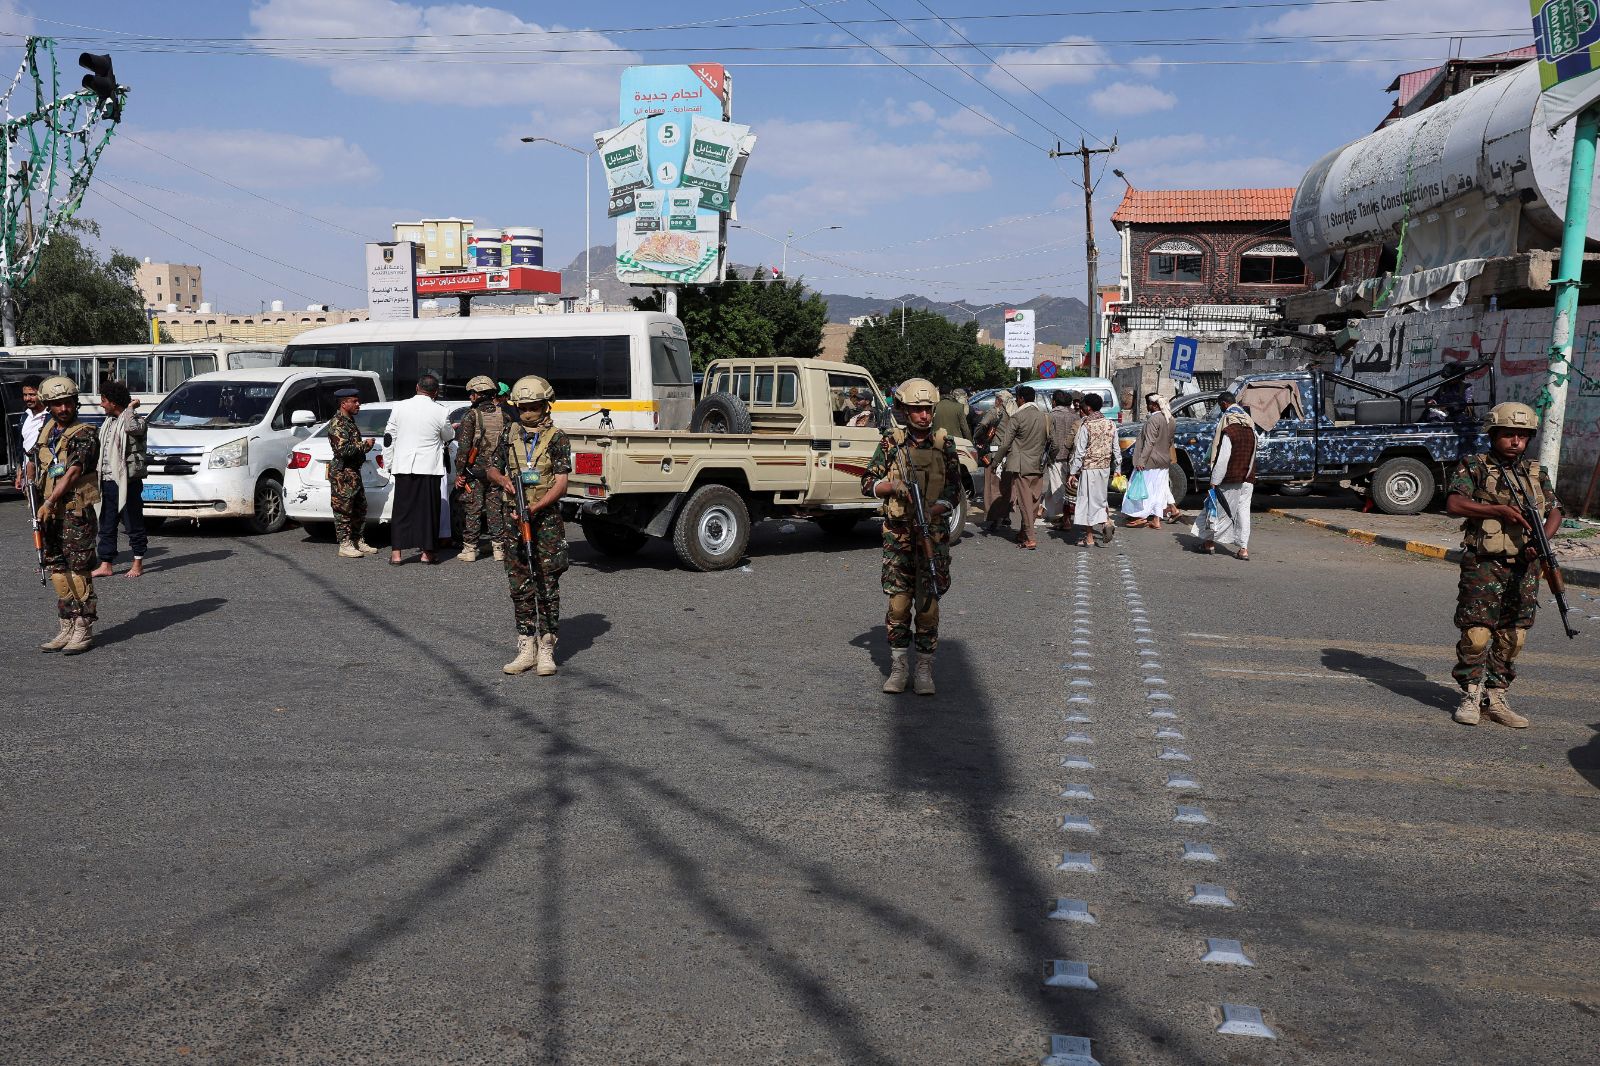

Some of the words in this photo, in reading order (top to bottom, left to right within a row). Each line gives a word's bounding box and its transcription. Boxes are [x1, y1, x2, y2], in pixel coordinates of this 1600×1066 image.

[698, 67, 719, 89] جديد
[634, 91, 668, 102] جديدة
[671, 86, 703, 101] أحجام
[664, 125, 674, 139] 5
[662, 165, 669, 177] 1
[1330, 208, 1358, 228] Storage
[1357, 198, 1380, 218] Tanks
[1380, 181, 1440, 211] Constructions
[1175, 343, 1192, 370] P
